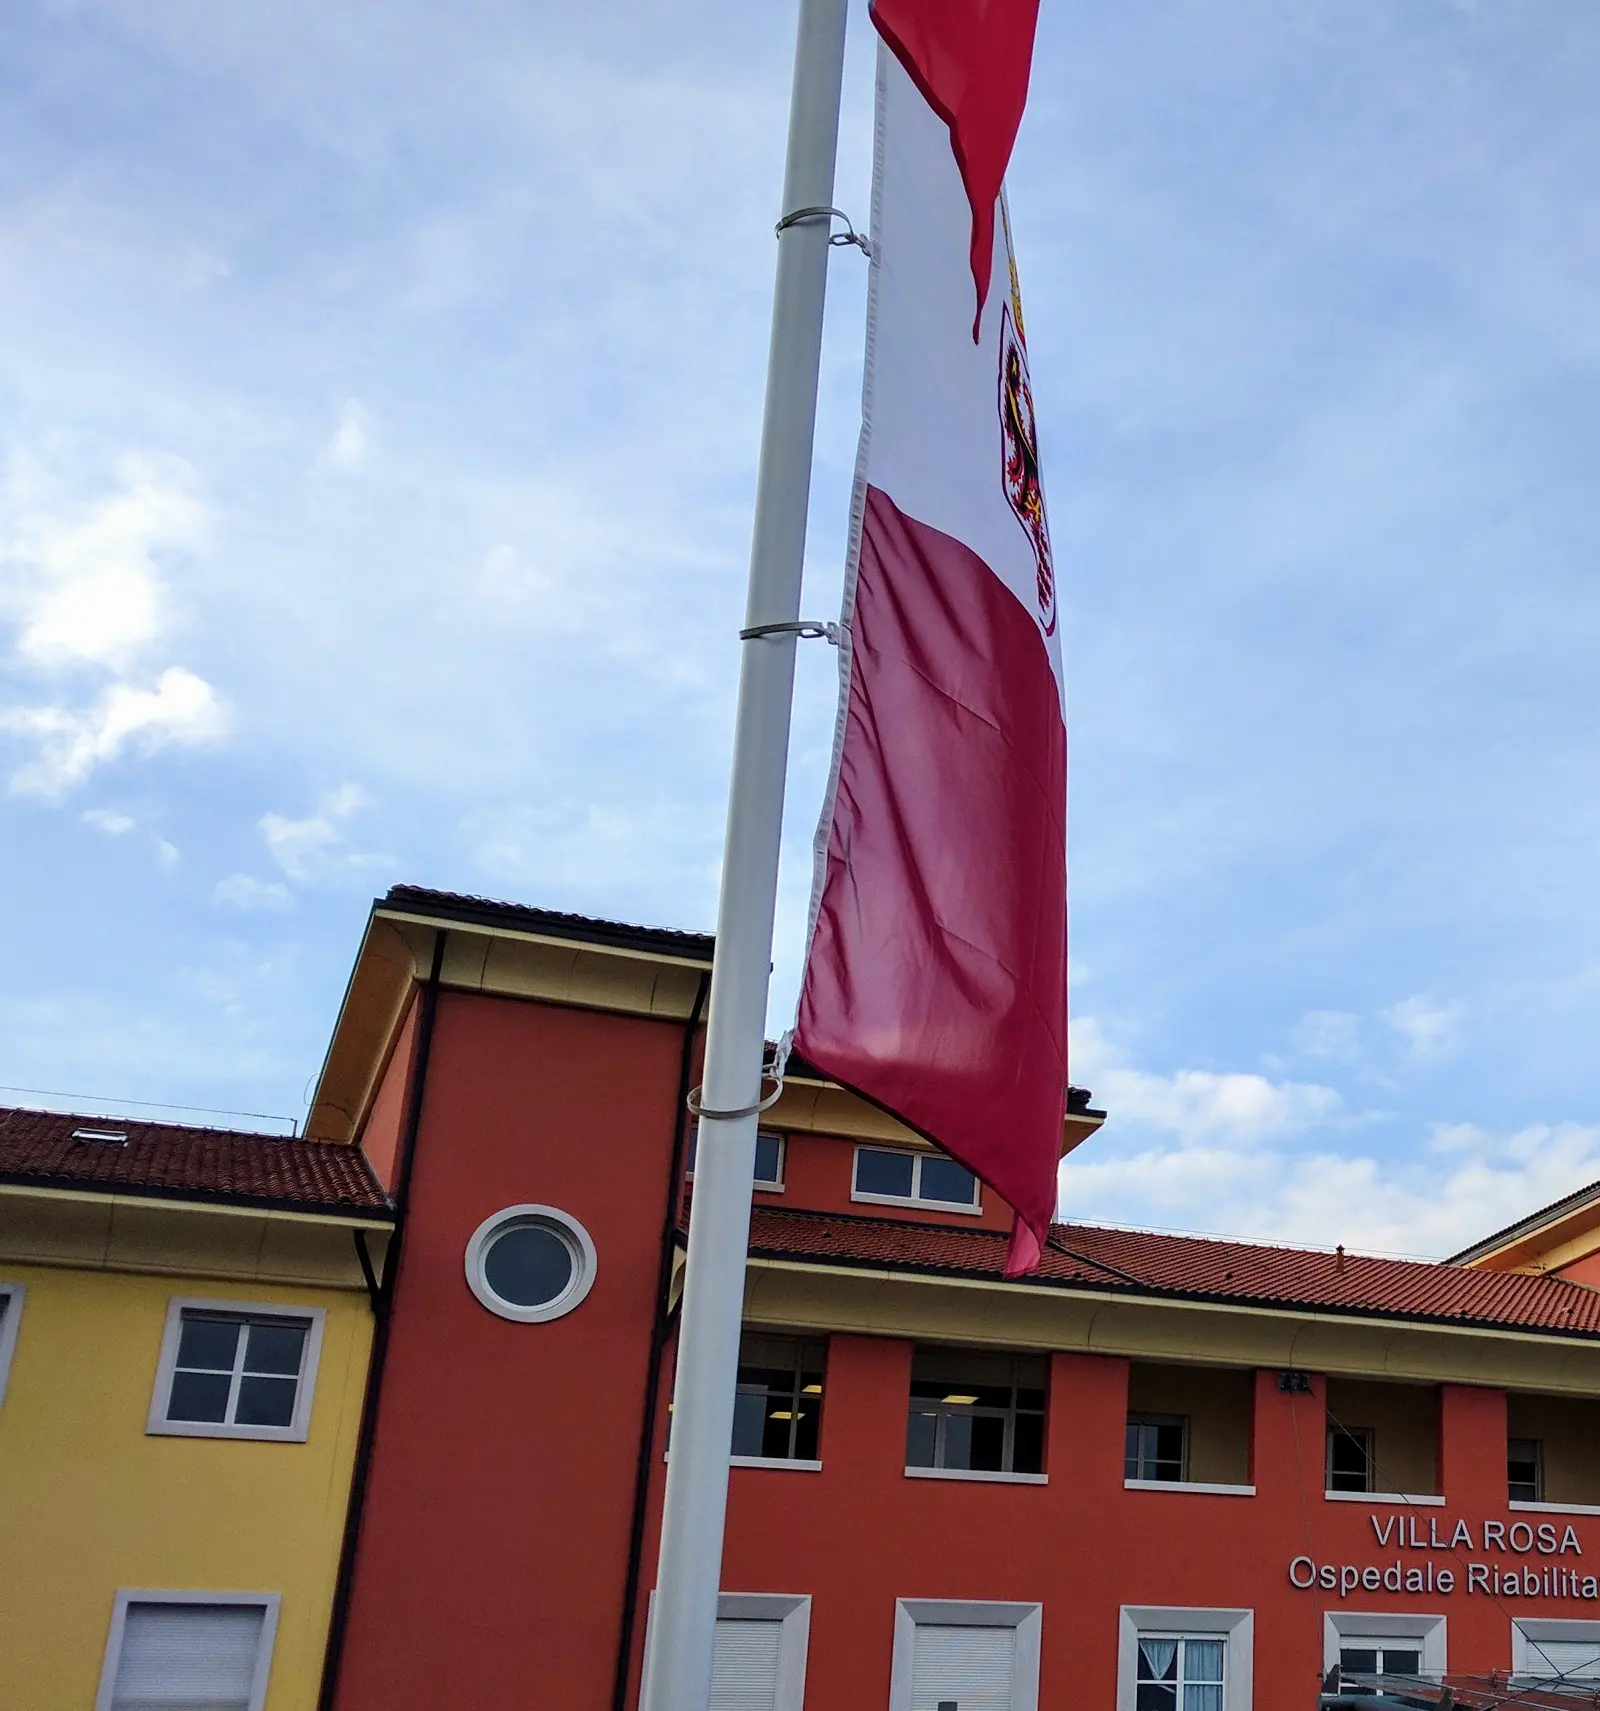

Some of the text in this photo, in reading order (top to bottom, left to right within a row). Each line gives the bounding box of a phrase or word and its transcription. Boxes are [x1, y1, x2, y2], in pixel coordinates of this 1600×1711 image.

[1371, 1514, 1582, 1555] VILLA ROSA
[1288, 1555, 1455, 1597] Ospedale
